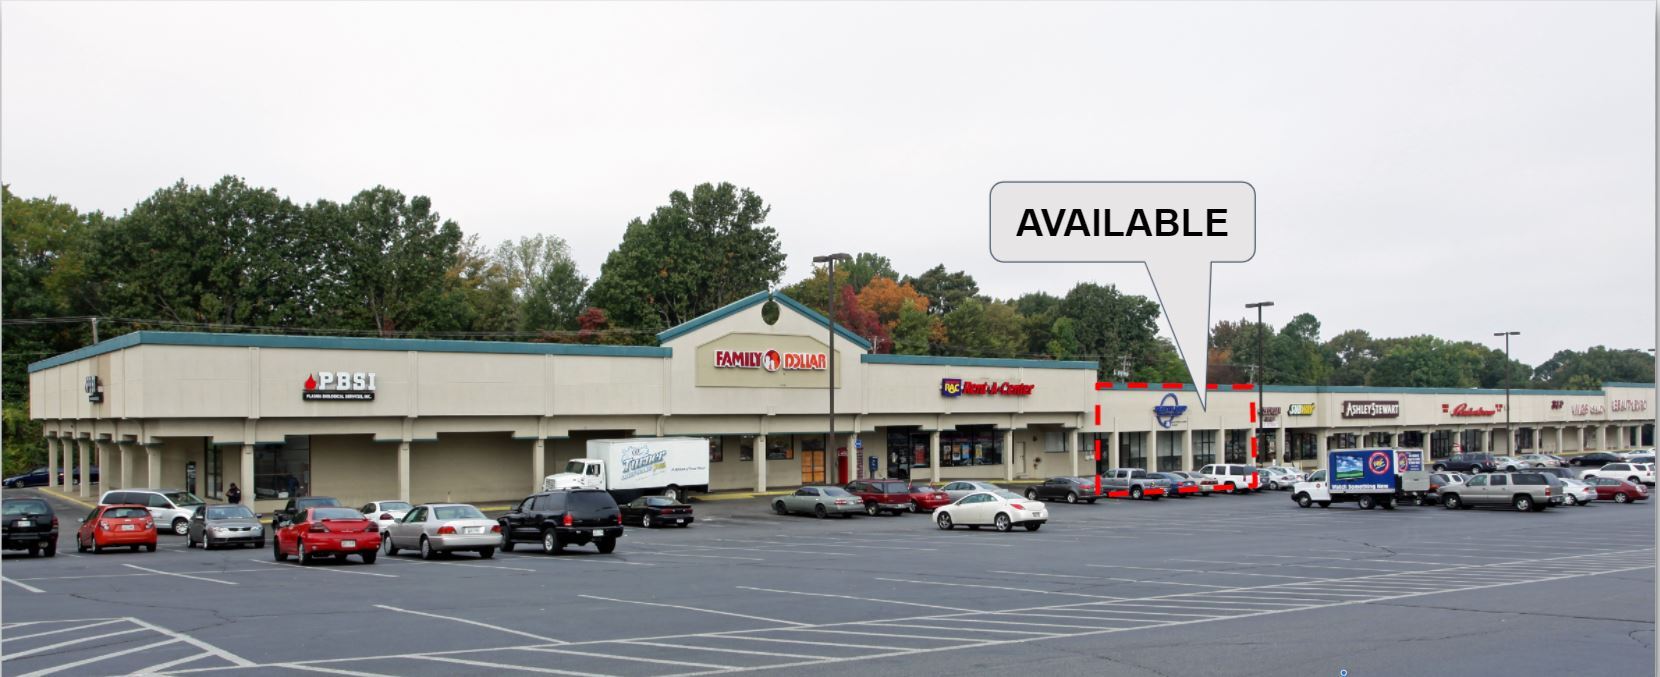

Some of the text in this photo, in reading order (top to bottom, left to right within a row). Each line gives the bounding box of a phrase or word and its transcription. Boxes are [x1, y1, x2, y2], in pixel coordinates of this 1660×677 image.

[715, 350, 827, 369] FAMILY DOLLAR
[318, 371, 376, 391] PBSI
[944, 383, 960, 394] RAC
[1290, 402, 1315, 416] SUBWAY
[1346, 403, 1399, 416] ASHLEY STEWART
[622, 449, 668, 474] Turner
